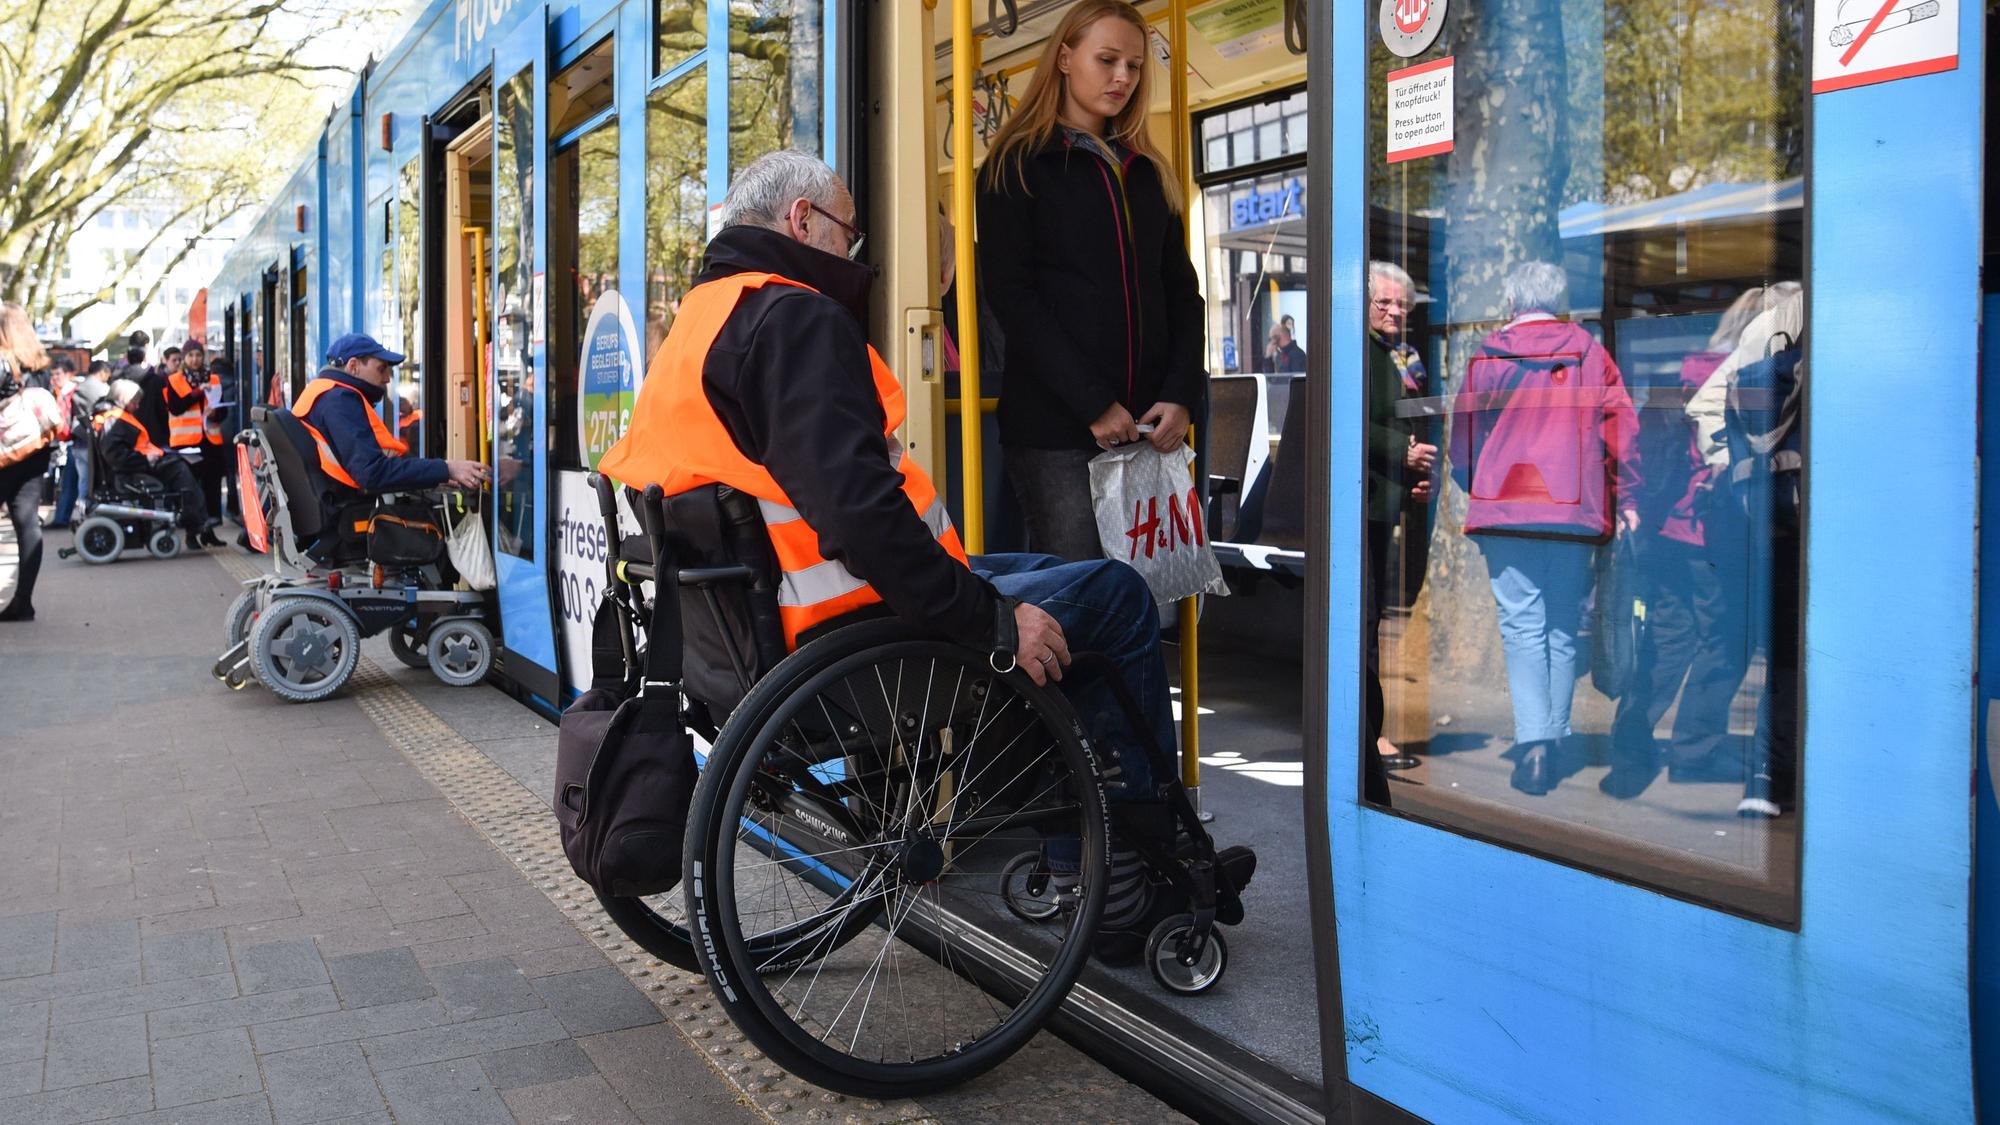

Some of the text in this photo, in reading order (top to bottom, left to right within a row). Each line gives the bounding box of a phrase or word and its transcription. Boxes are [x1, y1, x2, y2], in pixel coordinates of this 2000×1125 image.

[1395, 76, 1447, 98] Tür öffnet auf
[1395, 90, 1441, 110] Knopfdruck!
[1395, 112, 1442, 129] Press button
[1395, 121, 1446, 141] to open door!
[1232, 177, 1305, 227] start
[1125, 486, 1204, 561] H&M
[1079, 738, 1100, 777] PLUS
[693, 860, 738, 1003] SCHWALBE
